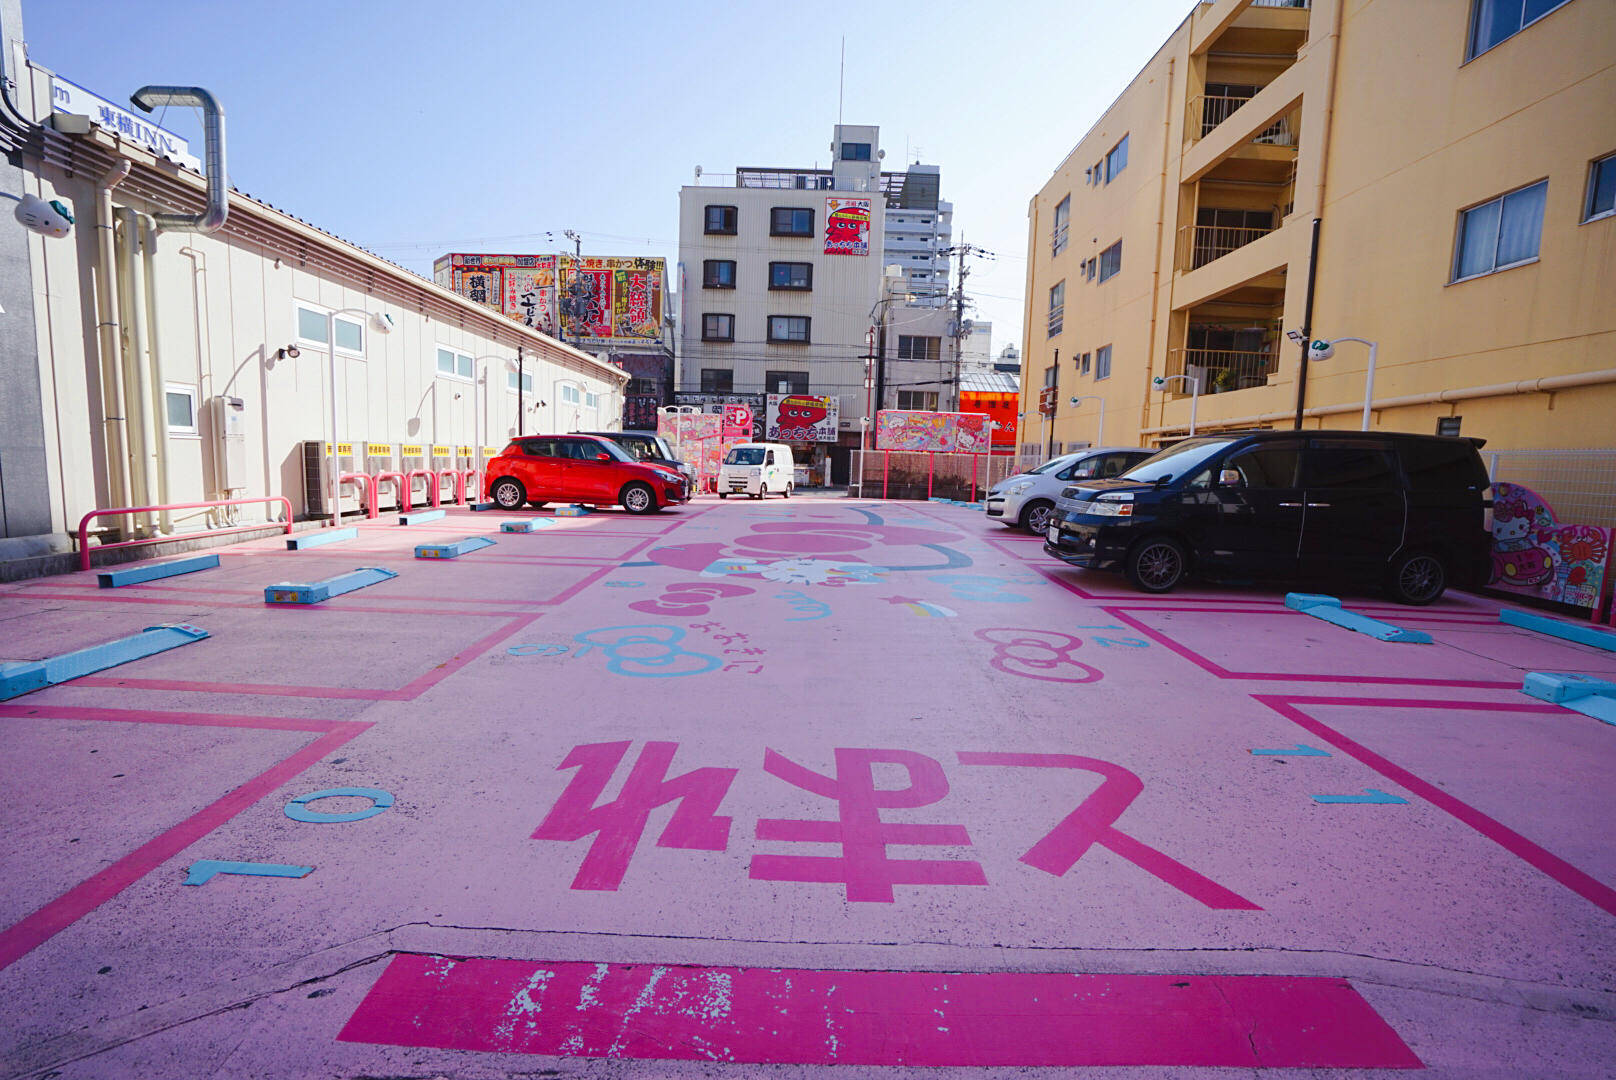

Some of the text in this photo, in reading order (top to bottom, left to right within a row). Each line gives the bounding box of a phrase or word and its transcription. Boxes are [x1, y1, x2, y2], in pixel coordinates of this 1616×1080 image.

[98, 105, 177, 152] 東横INN
[469, 274, 486, 303] 横綱
[508, 273, 517, 310] お好み焼き
[539, 289, 547, 311] 串かつ
[630, 273, 646, 324] 大統領
[736, 410, 747, 424] P
[327, 445, 352, 453] 普車専用
[531, 739, 1262, 912] とまれ
